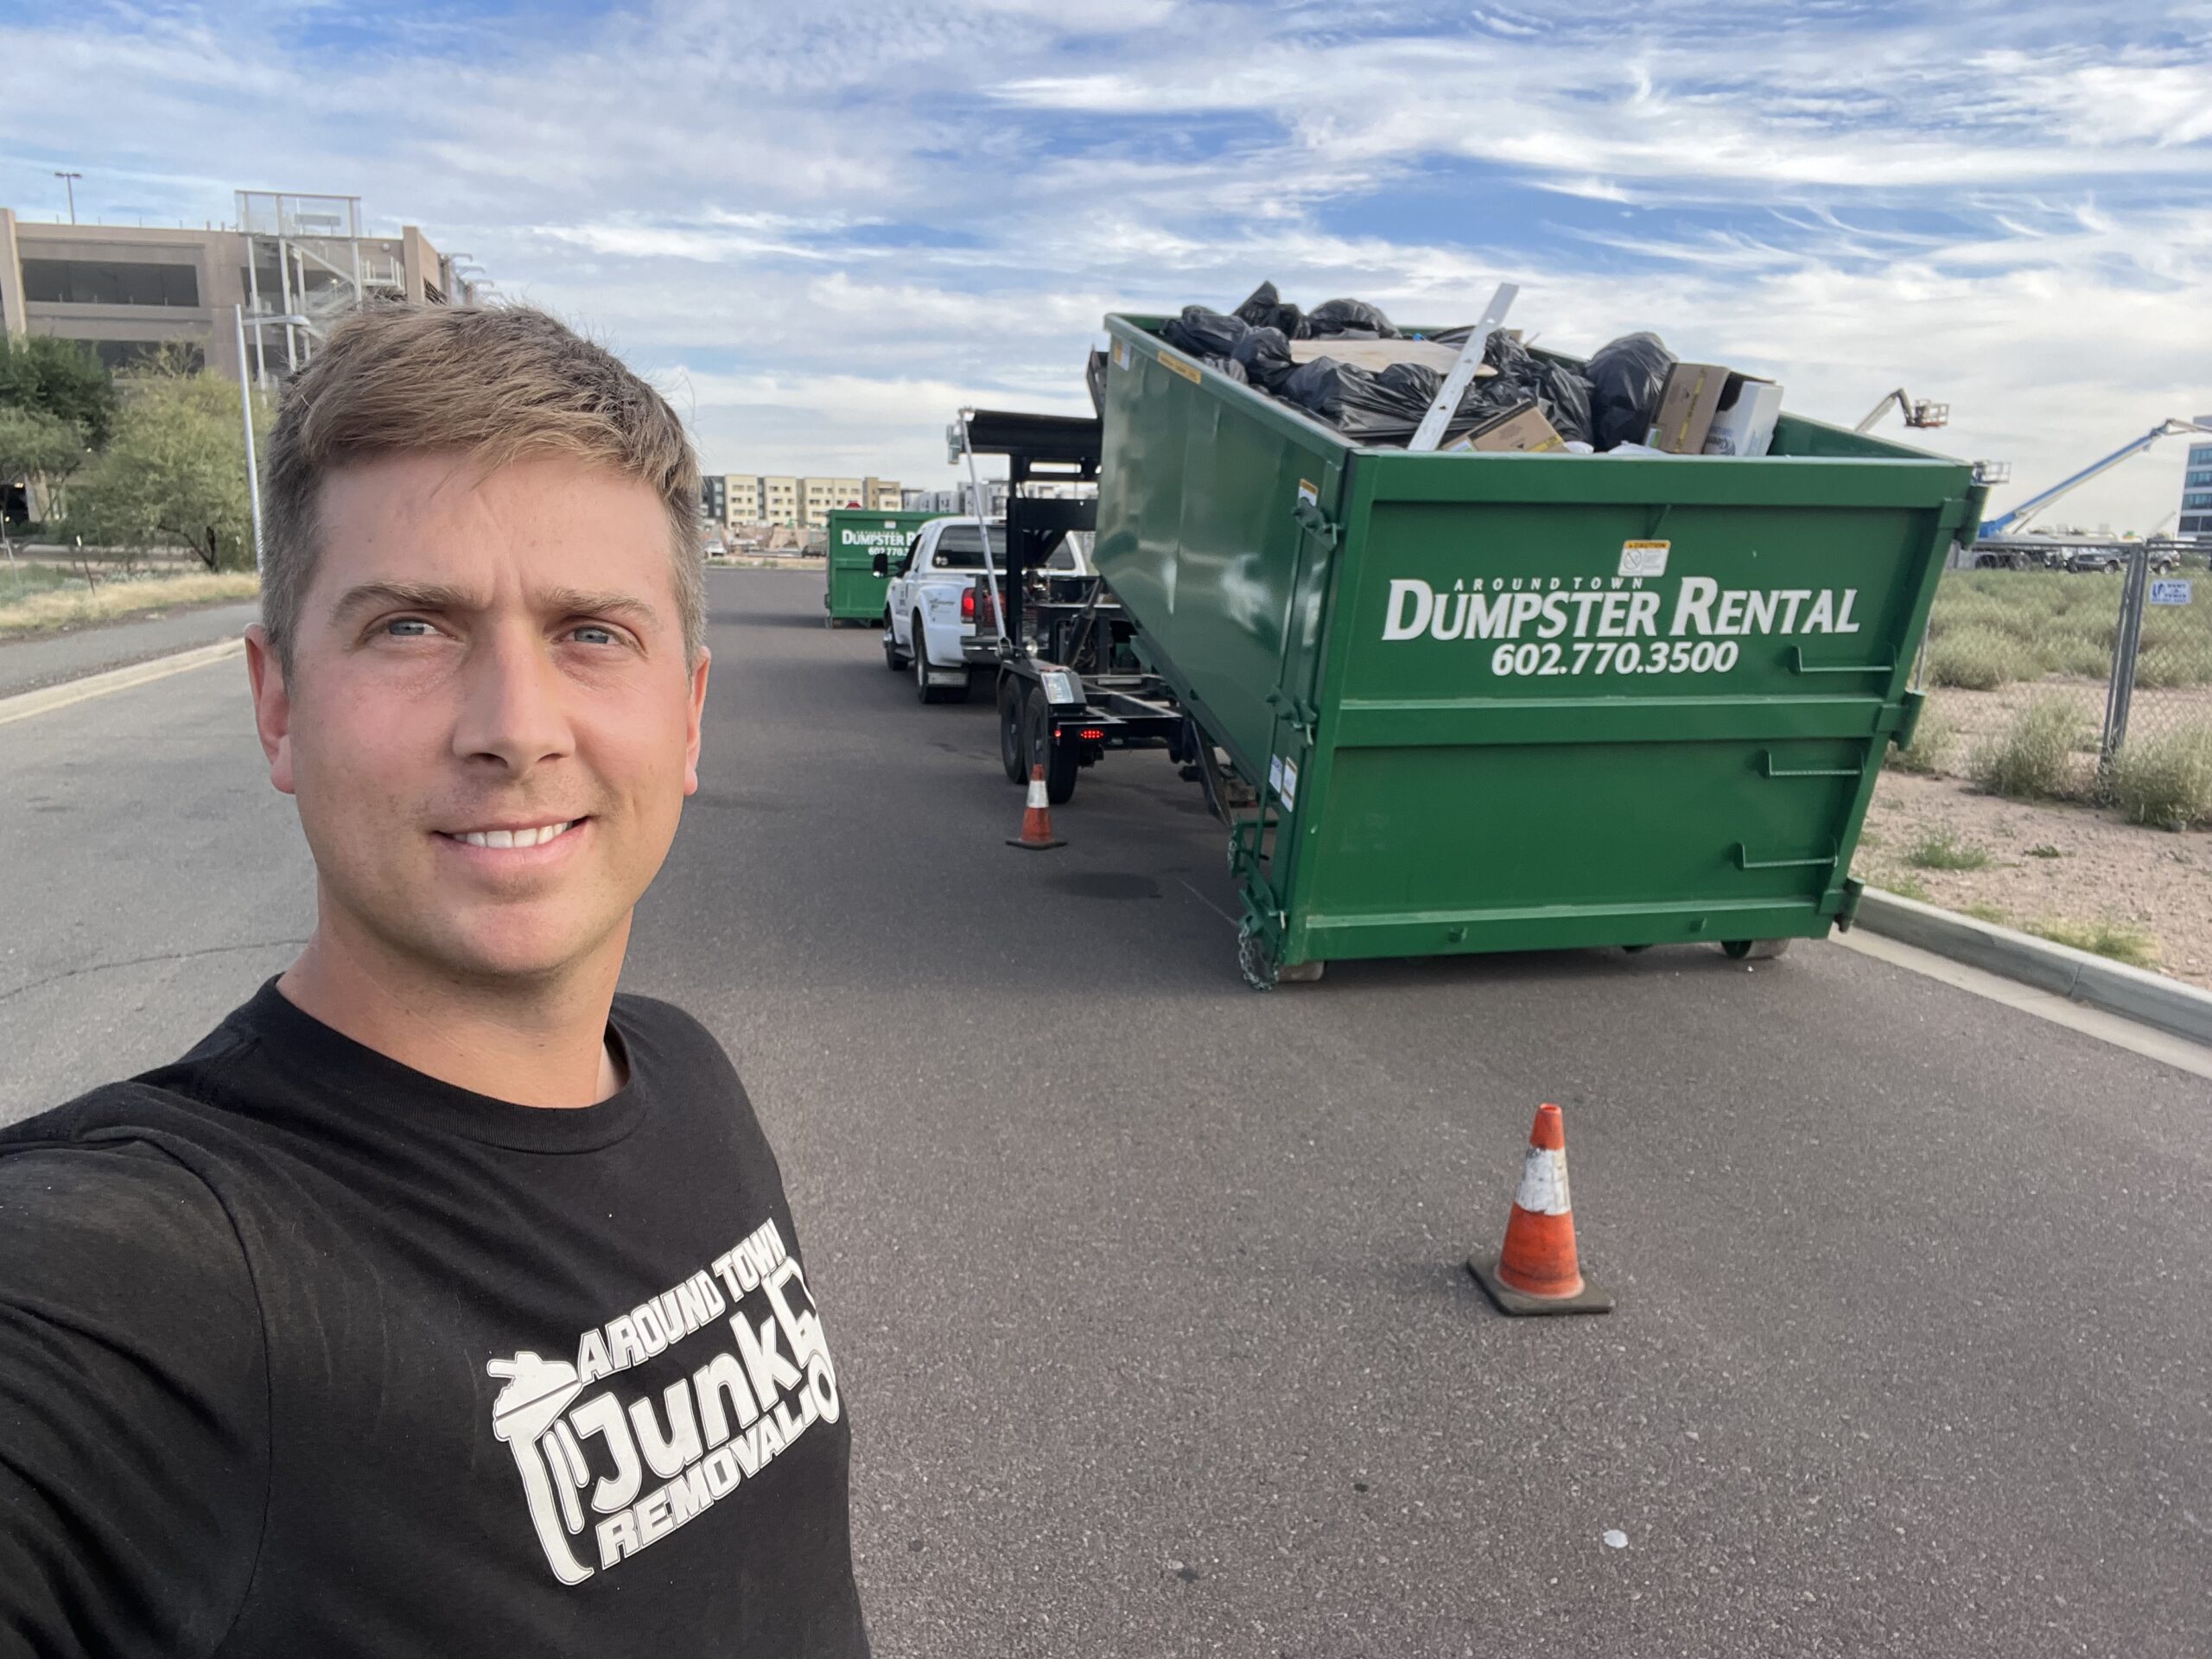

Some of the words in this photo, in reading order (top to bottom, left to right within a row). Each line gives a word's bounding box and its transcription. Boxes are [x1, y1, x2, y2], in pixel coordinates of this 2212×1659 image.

[842, 530, 904, 546] DUMPSTER
[1382, 578, 1661, 641] DUMPSTER
[1669, 576, 1859, 635] RENTAL
[1454, 577, 1560, 592] AROUND
[1573, 576, 1644, 591] TOWN
[1491, 639, 1739, 677] 602.770.3500
[578, 1268, 726, 1386] AROUND
[711, 1217, 786, 1303] TOWN
[569, 1311, 803, 1513] Junk
[595, 1401, 806, 1571] REMOVAL
